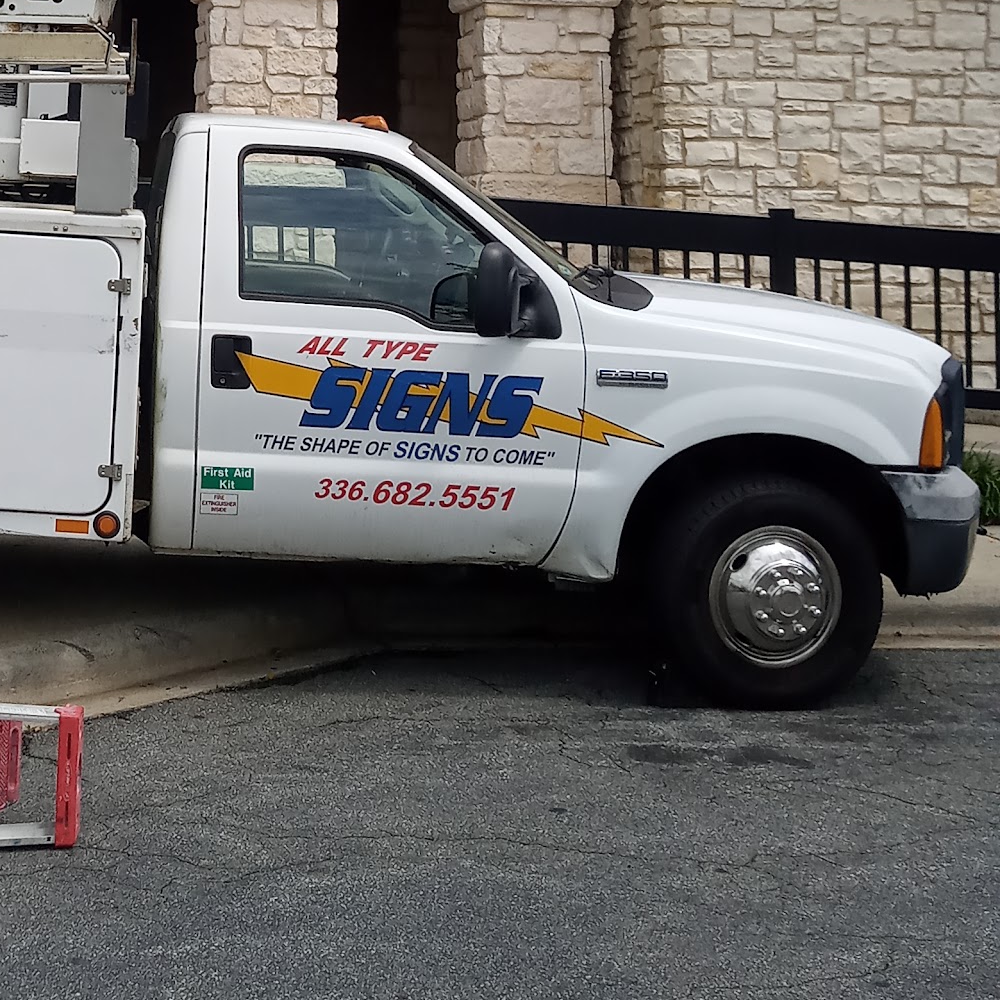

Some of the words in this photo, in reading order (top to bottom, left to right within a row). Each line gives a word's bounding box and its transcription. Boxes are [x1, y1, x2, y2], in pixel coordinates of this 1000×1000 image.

[297, 336, 349, 357] ALL
[362, 339, 439, 362] TYPE
[299, 366, 544, 439] SIGNS
[300, 437, 362, 455] SHAPE
[365, 441, 391, 456] OF
[393, 441, 461, 462] SIGNS
[465, 446, 488, 462] TO
[203, 467, 229, 478] First
[233, 468, 252, 478] Aid
[219, 479, 236, 490] Kit
[314, 478, 516, 511] 336.682.5551
